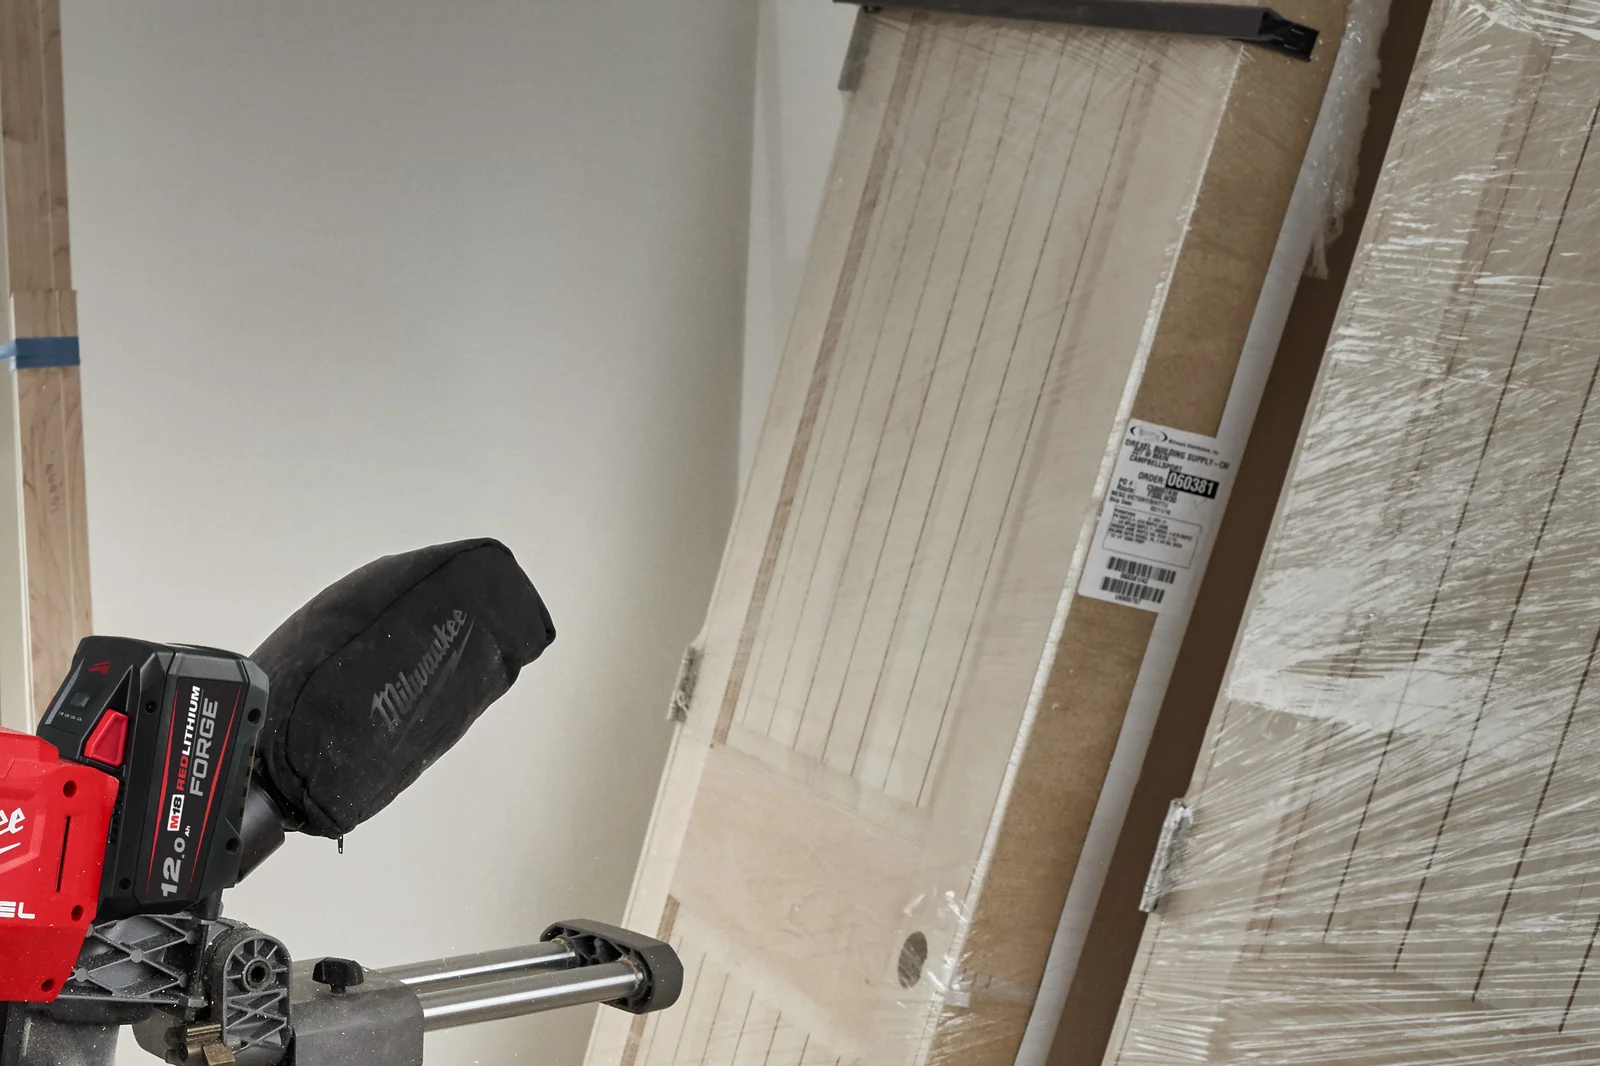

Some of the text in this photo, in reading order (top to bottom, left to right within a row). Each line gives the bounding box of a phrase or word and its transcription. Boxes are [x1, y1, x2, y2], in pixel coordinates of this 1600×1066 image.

[1130, 455, 1183, 471] CAMPBELLSPORT
[1154, 445, 1185, 459] BUILDING
[1167, 472, 1215, 496] 060381
[370, 609, 467, 733] Milwaukee
[189, 697, 219, 797] FORGE
[168, 796, 183, 830] M18
[161, 825, 191, 897] 12.0 Ah
